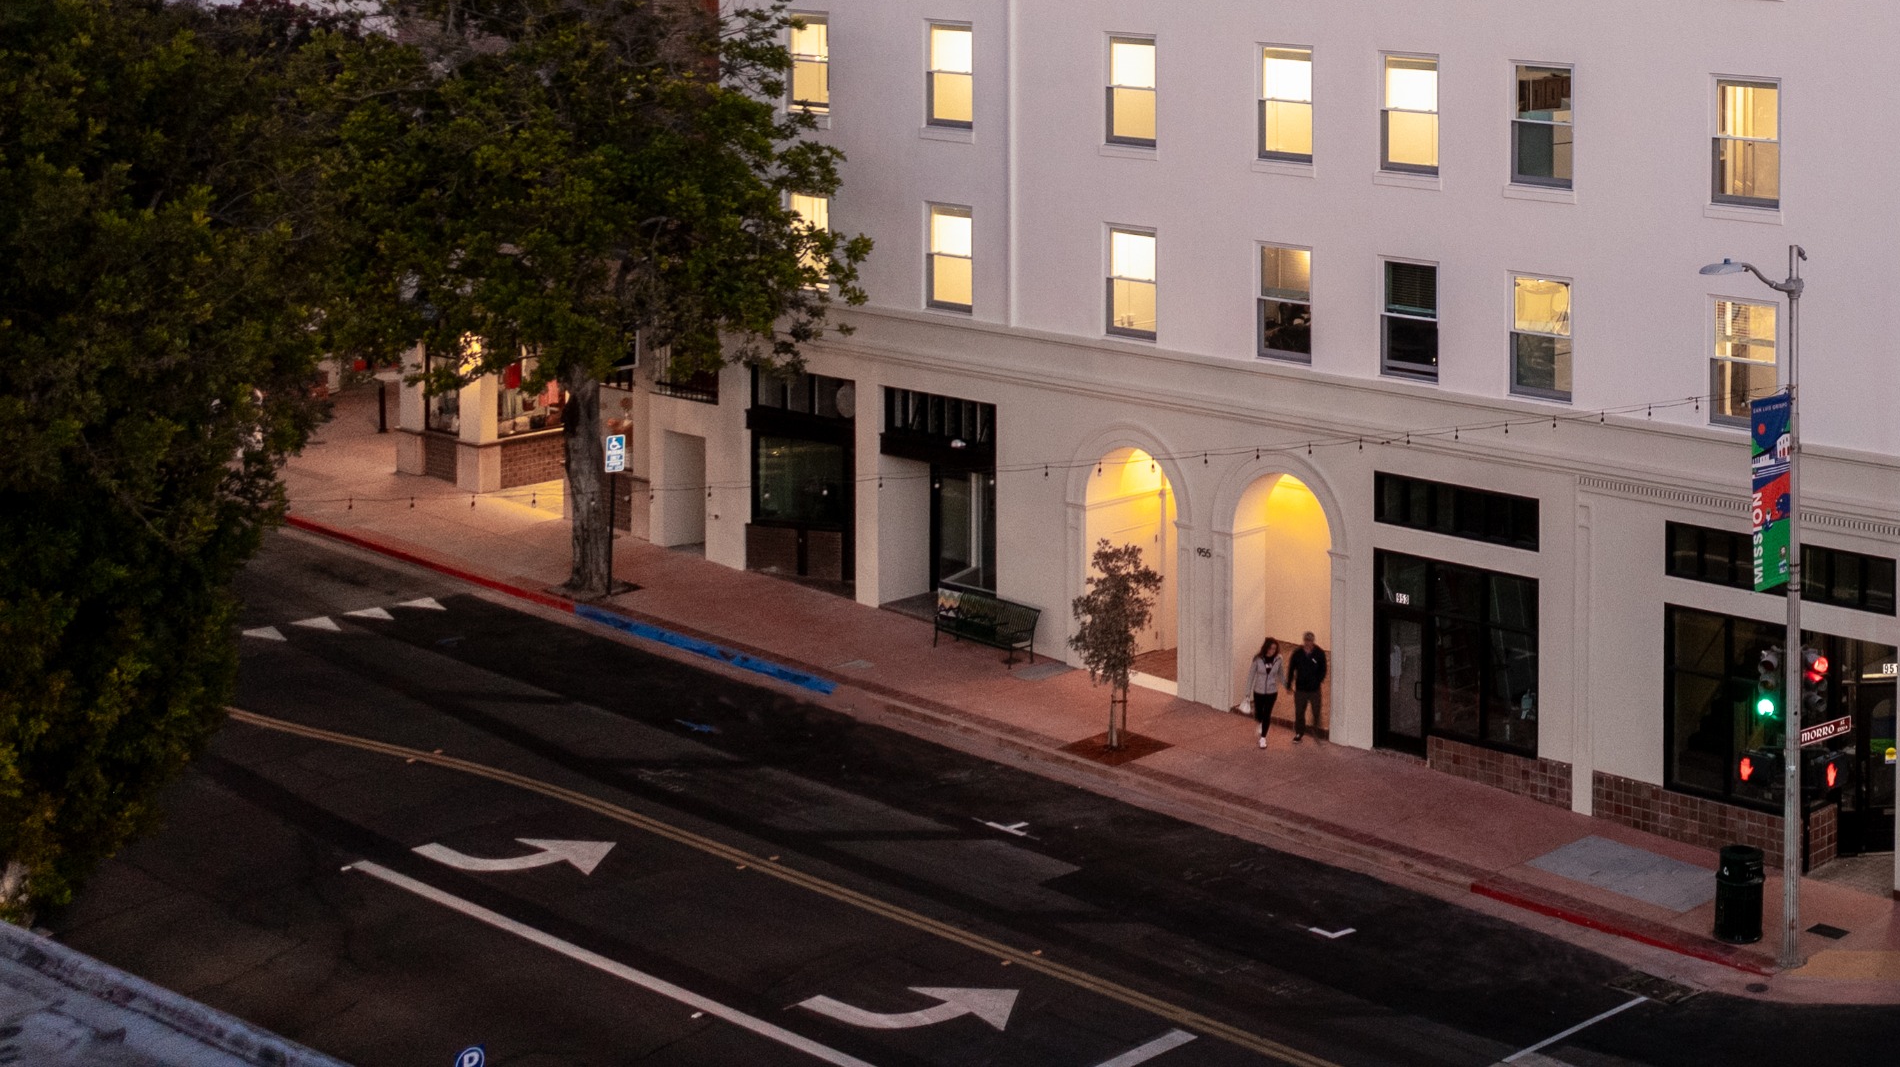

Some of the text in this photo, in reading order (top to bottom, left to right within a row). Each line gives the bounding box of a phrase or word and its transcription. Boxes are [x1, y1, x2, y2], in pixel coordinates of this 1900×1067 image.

[1753, 492, 1763, 585] MISSION
[1197, 547, 1211, 558] 955
[1801, 724, 1835, 742] MORRO
[464, 1051, 480, 1067] P
